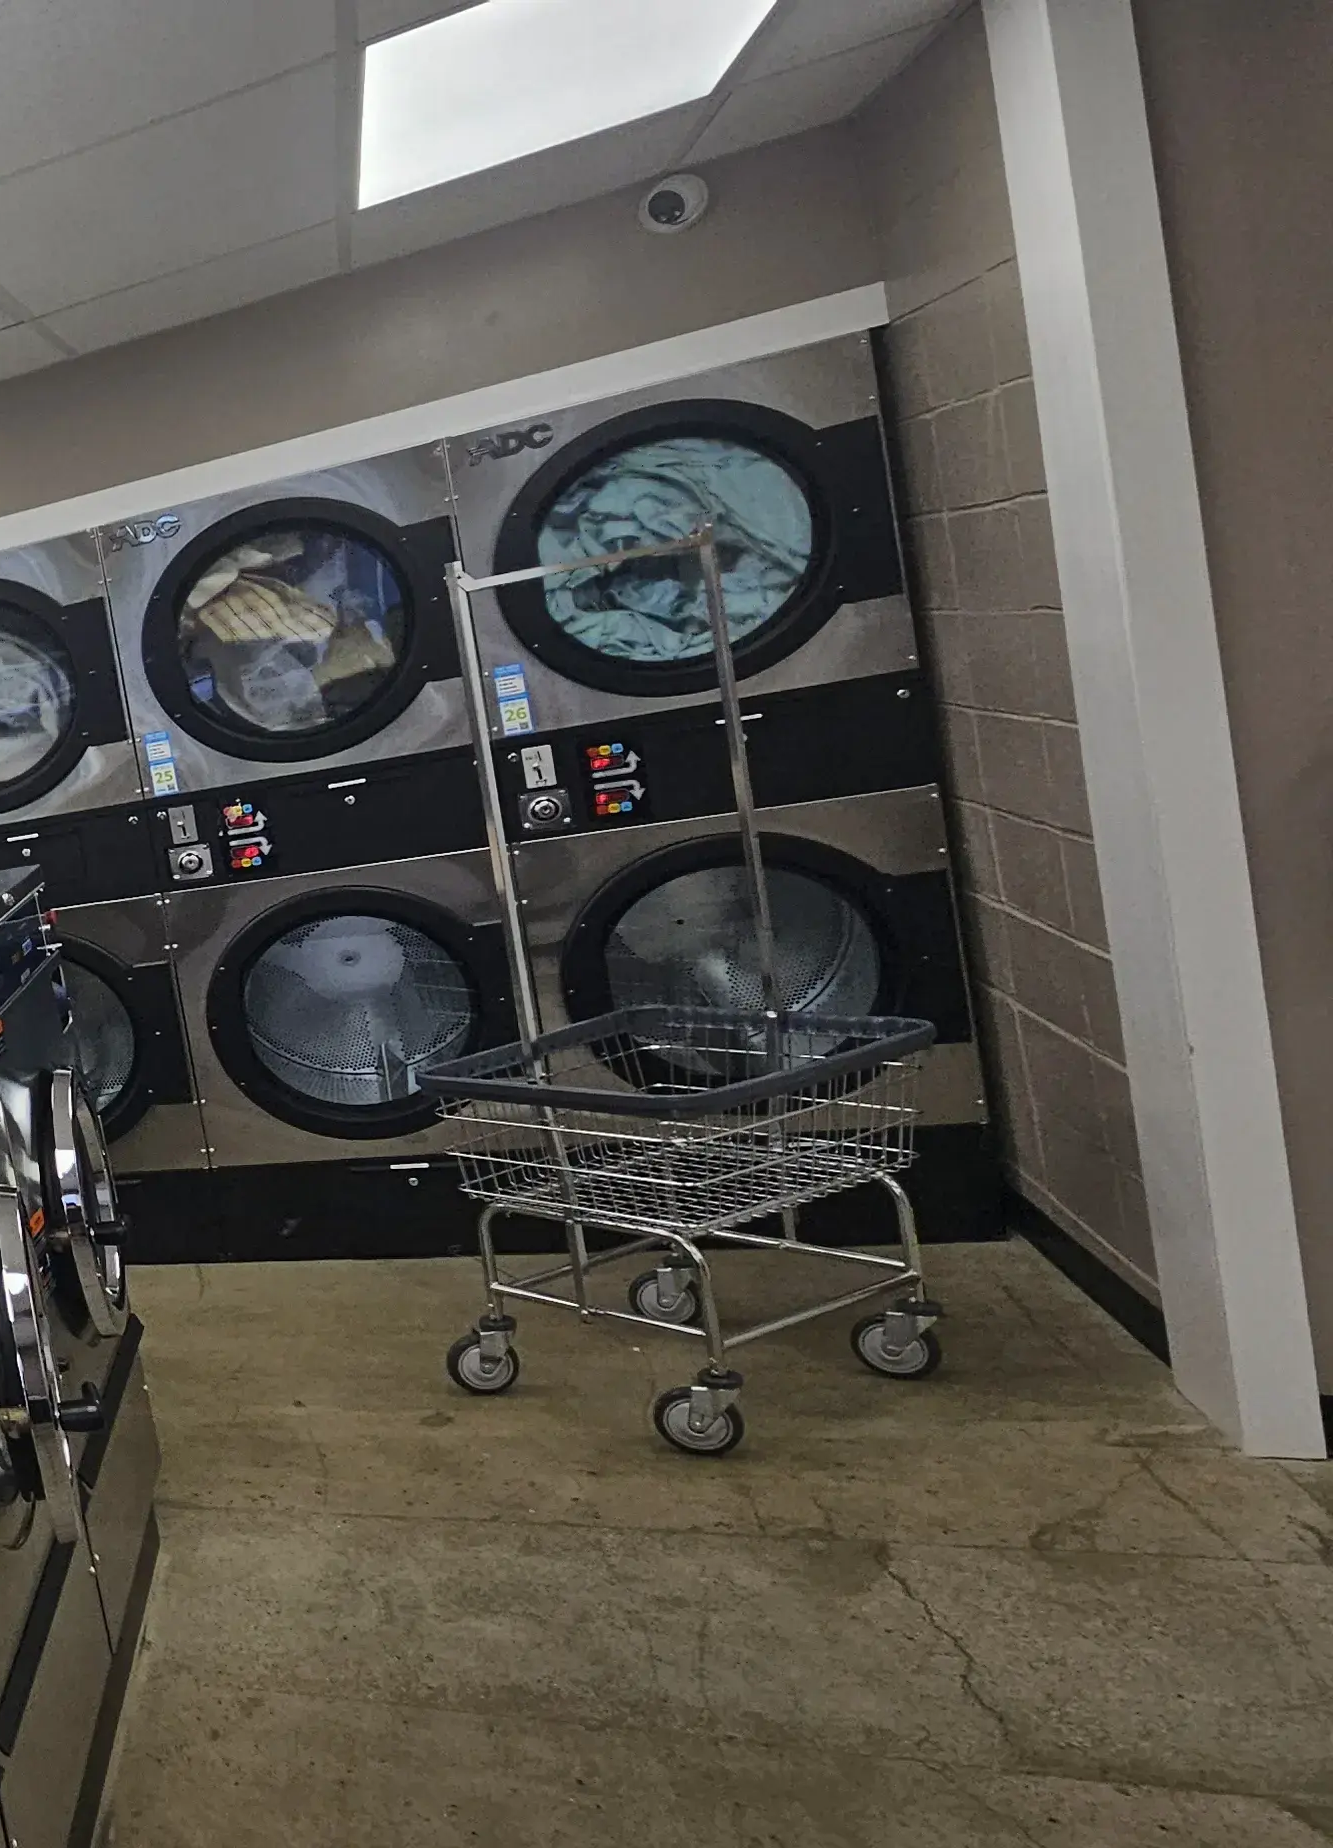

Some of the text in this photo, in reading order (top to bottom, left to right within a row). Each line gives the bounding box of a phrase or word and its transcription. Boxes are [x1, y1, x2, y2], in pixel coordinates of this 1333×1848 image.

[466, 422, 553, 467] ADC
[108, 512, 183, 553] ADC
[504, 707, 527, 722] 26
[154, 770, 174, 784] 25
